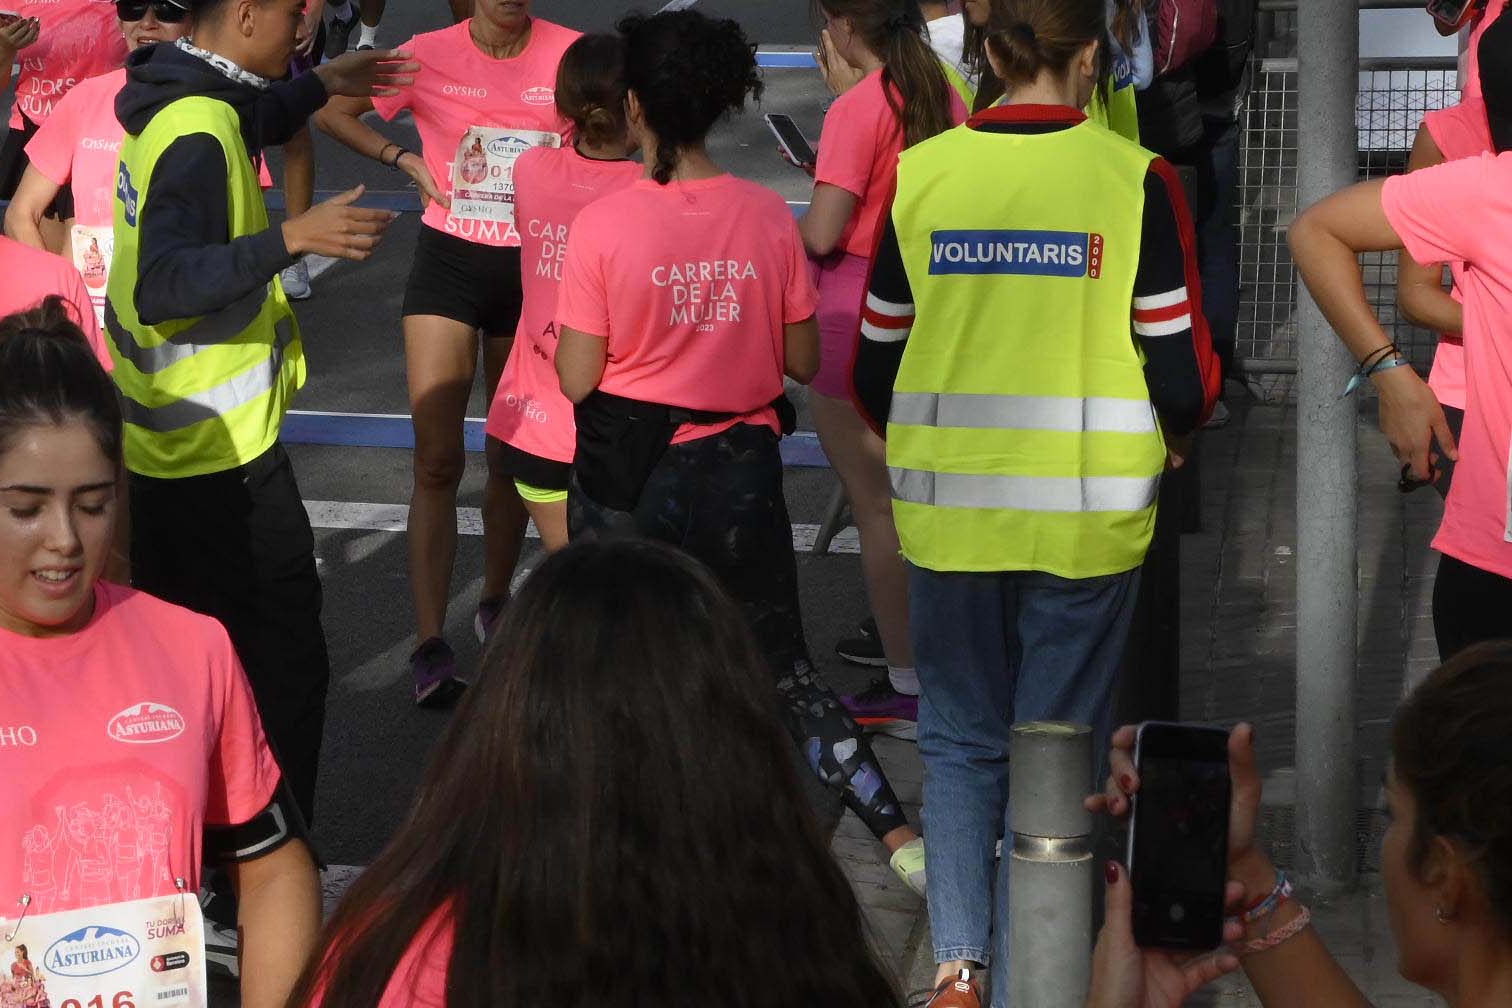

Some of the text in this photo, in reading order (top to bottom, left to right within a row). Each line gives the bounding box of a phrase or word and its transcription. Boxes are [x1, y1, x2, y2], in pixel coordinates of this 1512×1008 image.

[442, 84, 486, 98] OYSHO
[490, 164, 513, 179] 01
[493, 182, 514, 192] 1370
[444, 218, 520, 241] SUMA
[932, 242, 1083, 266] VOLUNTARIS
[1090, 235, 1101, 279] 2000
[651, 260, 758, 287] CARRERA
[672, 282, 737, 305] DE LA
[669, 302, 741, 326] MUJER
[115, 717, 182, 738] ASTURIANA
[147, 924, 186, 940] SUMA
[51, 946, 133, 969] ASTURIANA
